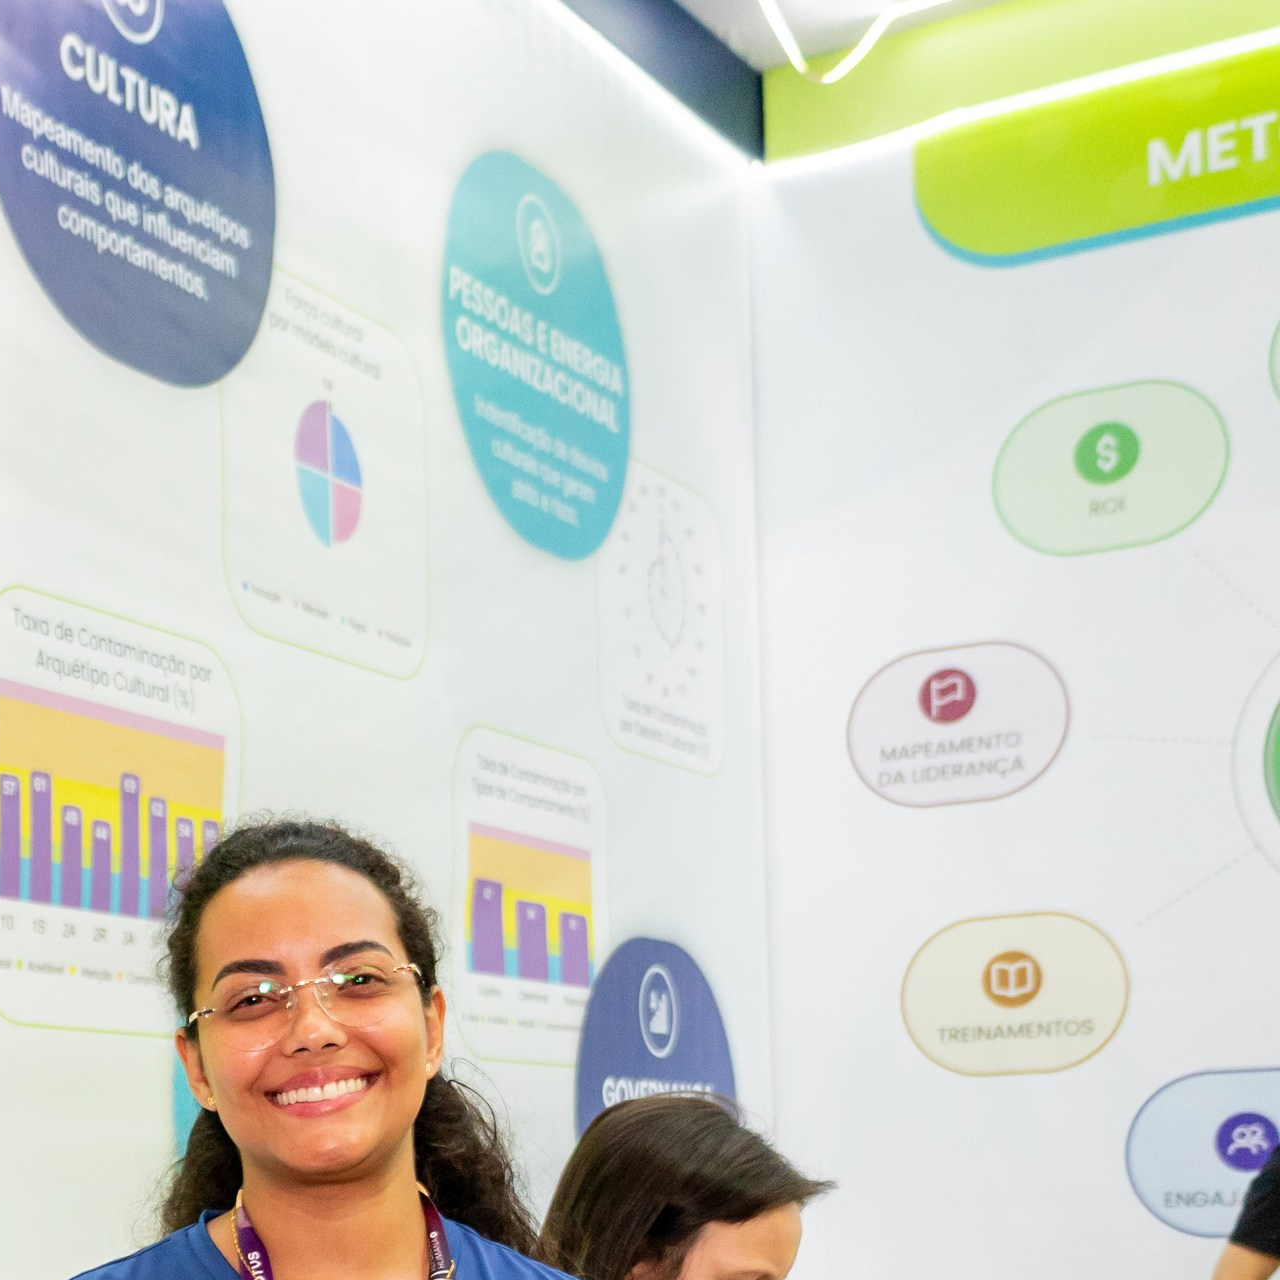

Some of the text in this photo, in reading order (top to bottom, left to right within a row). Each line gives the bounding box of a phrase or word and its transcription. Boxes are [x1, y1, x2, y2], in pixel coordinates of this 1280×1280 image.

[59, 33, 199, 150] CULTURA
[1, 85, 125, 179] Mapeamento
[128, 162, 161, 200] dos
[1146, 111, 1280, 186] MET
[21, 144, 237, 278] culturais que influenciam
[449, 266, 623, 398] PESSOAS E ENERGIA
[455, 316, 619, 433] ORGANIZACIONAL
[12, 607, 50, 637] Taxa
[55, 621, 74, 644] de
[113, 671, 170, 704] Cultural
[877, 756, 1025, 788] DA LIDERANÇA
[879, 731, 1023, 762] MAPEAMENTO
[937, 1018, 1095, 1044] TREINAMENTOS
